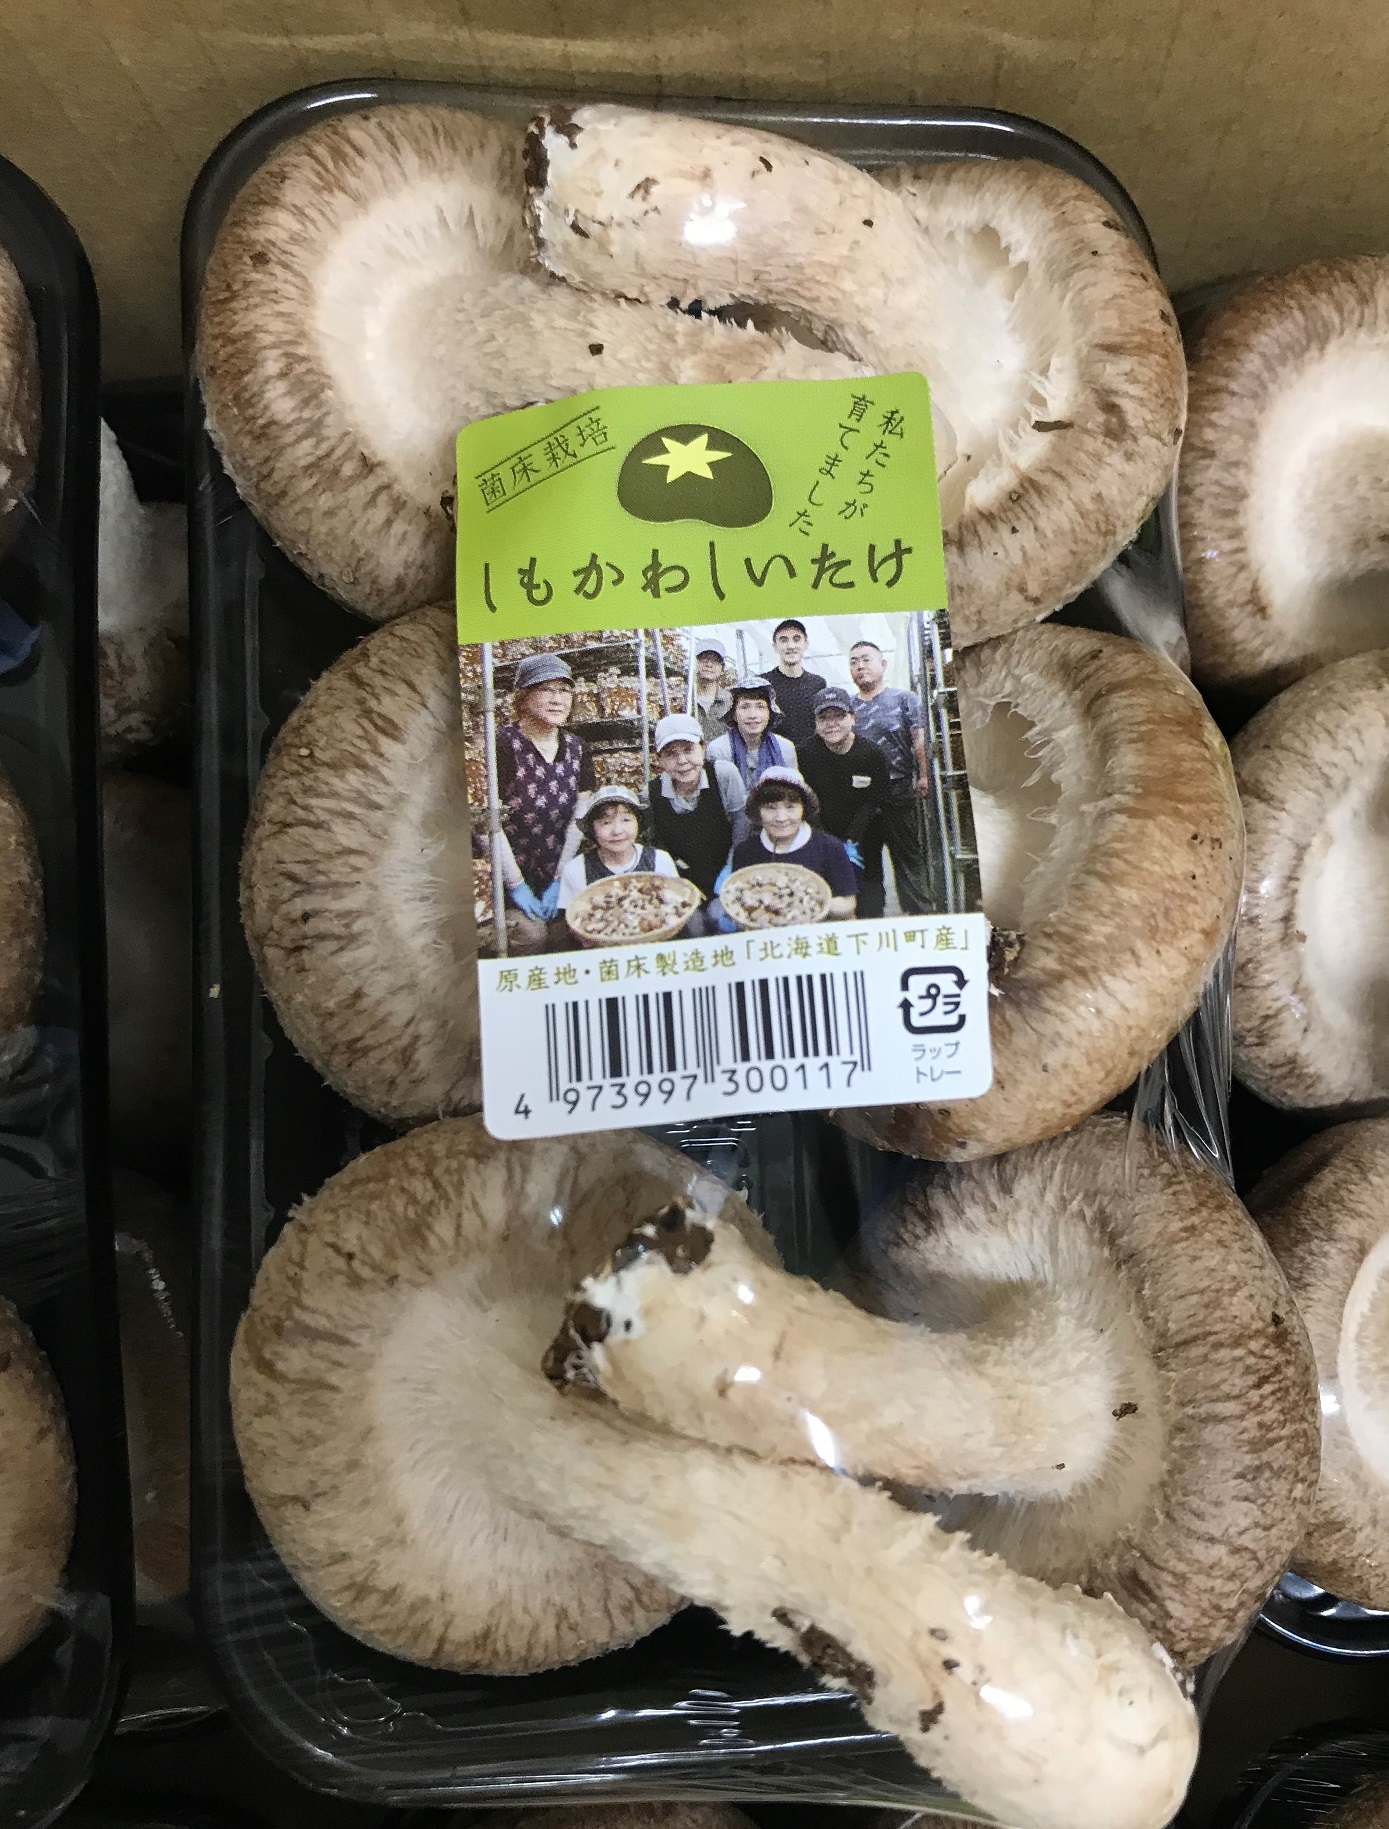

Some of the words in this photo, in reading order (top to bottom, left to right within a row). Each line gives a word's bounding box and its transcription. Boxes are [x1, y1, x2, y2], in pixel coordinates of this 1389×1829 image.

[476, 417, 611, 507] 菌床栽培
[789, 394, 875, 536] 育てました
[838, 408, 906, 520] 私たちが
[484, 539, 914, 613] しもかわしいたけ
[918, 982, 963, 1017] プラ
[912, 1041, 962, 1062] ラップ
[915, 1066, 963, 1085] トレー
[514, 1093, 533, 1121] 4
[563, 1075, 700, 1116] 973997
[722, 1060, 860, 1098] 300117
